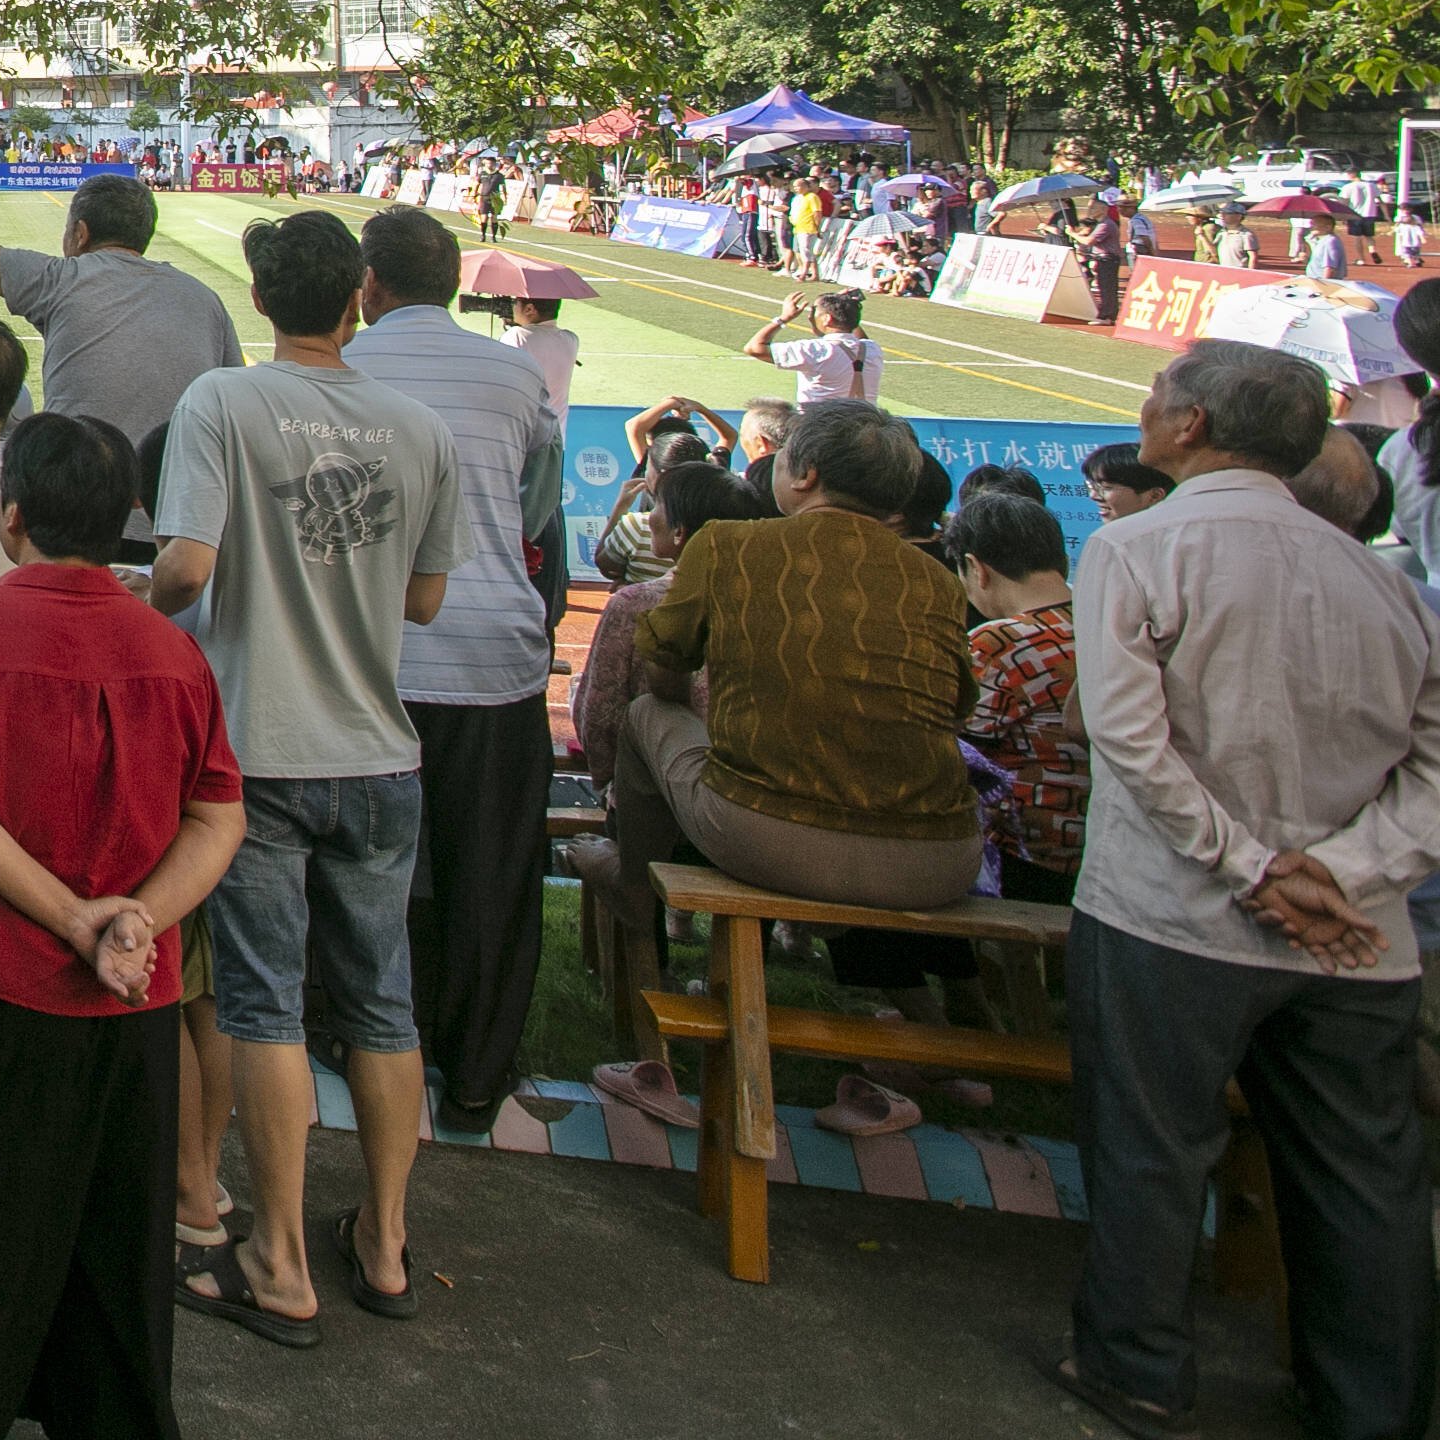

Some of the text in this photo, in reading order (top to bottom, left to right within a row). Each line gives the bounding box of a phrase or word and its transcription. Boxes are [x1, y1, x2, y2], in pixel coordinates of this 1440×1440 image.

[196, 168, 282, 188] 金河饭店
[980, 245, 1059, 291] 南国公馆
[279, 418, 361, 442] BEARBEAR
[584, 466, 610, 478] 排酸
